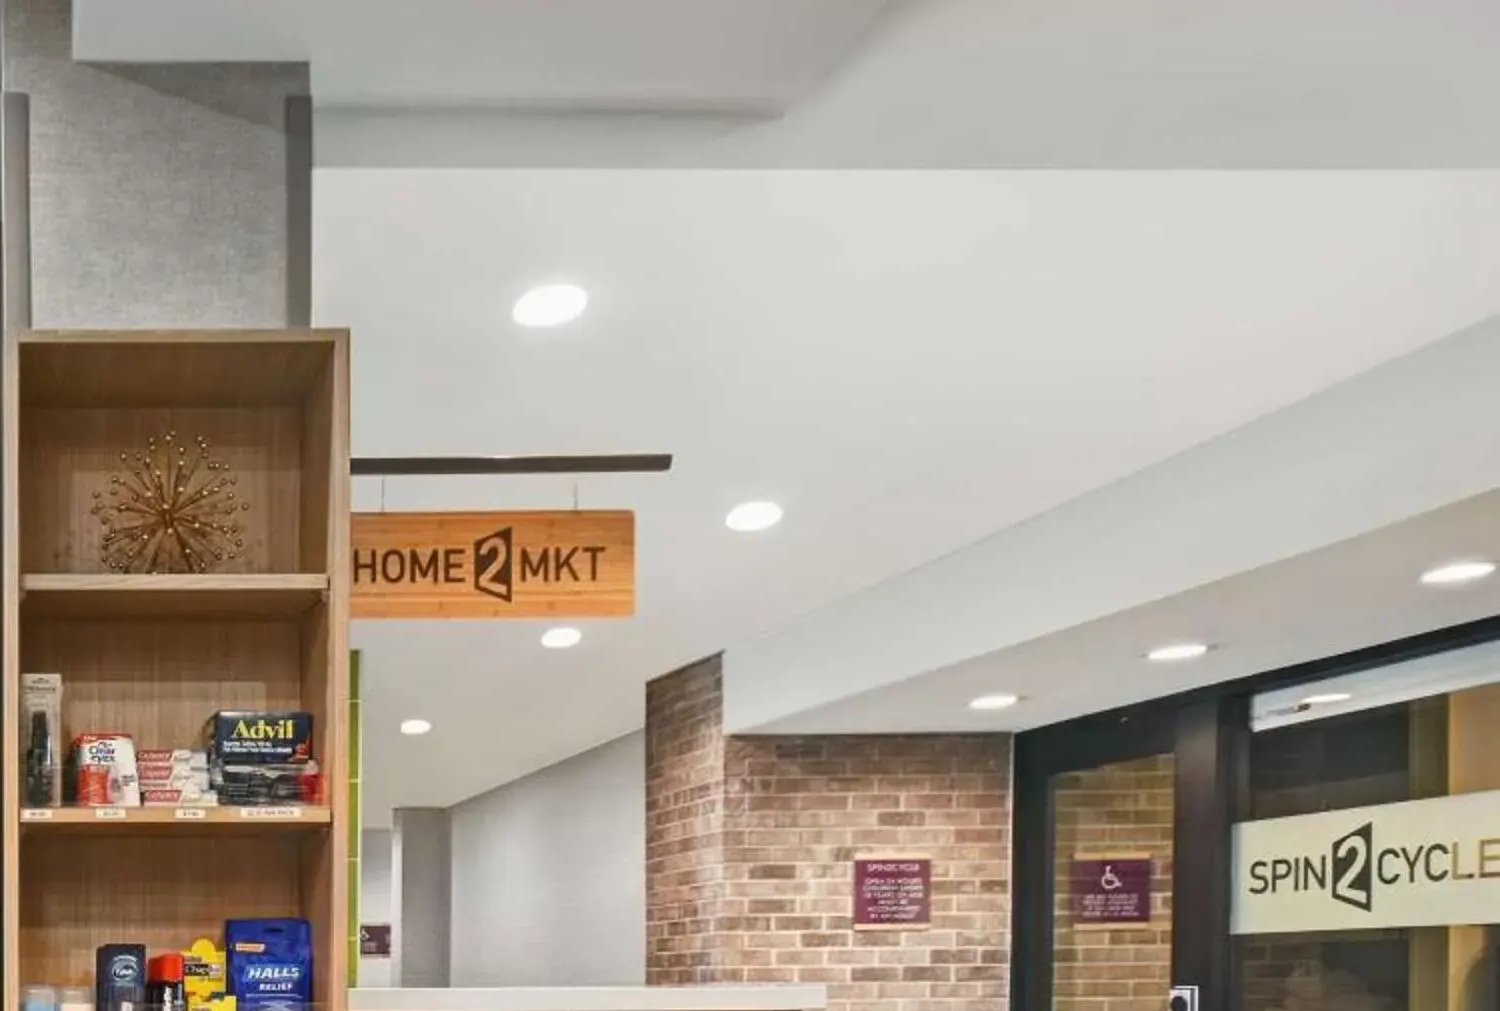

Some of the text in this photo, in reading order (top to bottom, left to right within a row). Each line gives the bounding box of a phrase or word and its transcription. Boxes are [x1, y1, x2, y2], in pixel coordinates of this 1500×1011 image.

[232, 720, 294, 739] Advil
[248, 966, 301, 979] HALLS
[259, 983, 293, 991] RELIEF
